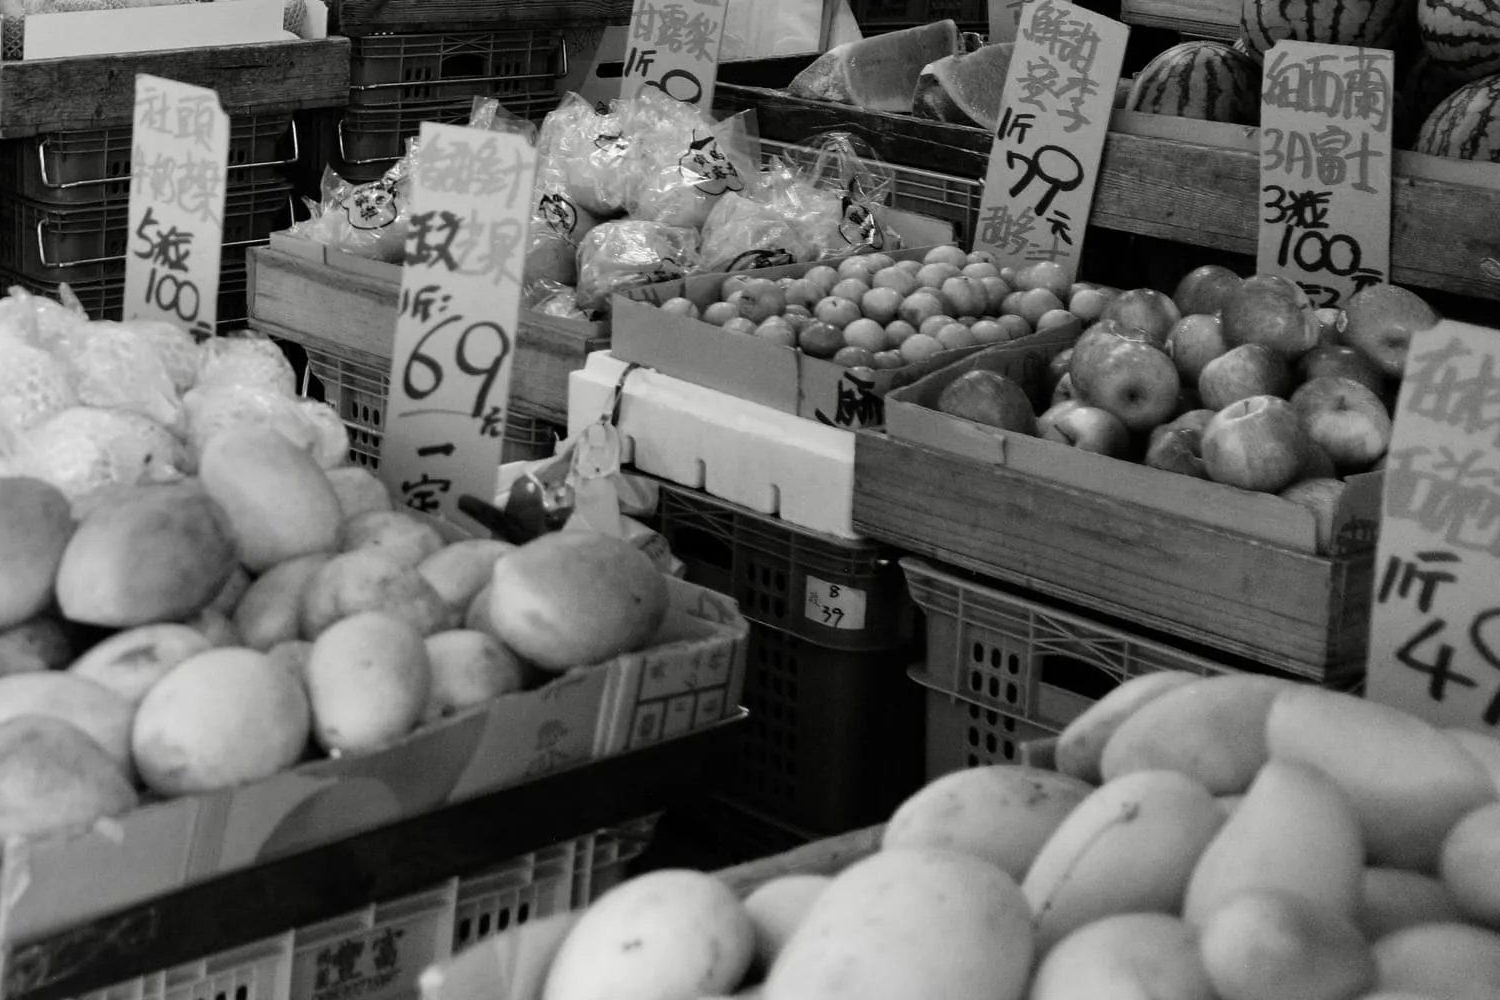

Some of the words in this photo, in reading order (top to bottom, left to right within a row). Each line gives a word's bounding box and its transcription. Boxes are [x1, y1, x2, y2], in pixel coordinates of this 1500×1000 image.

[1007, 144, 1084, 216] 79
[1278, 224, 1362, 276] 100
[146, 267, 199, 322] 100
[403, 315, 511, 418] 69
[821, 606, 844, 628] 39
[829, 585, 840, 598] 8
